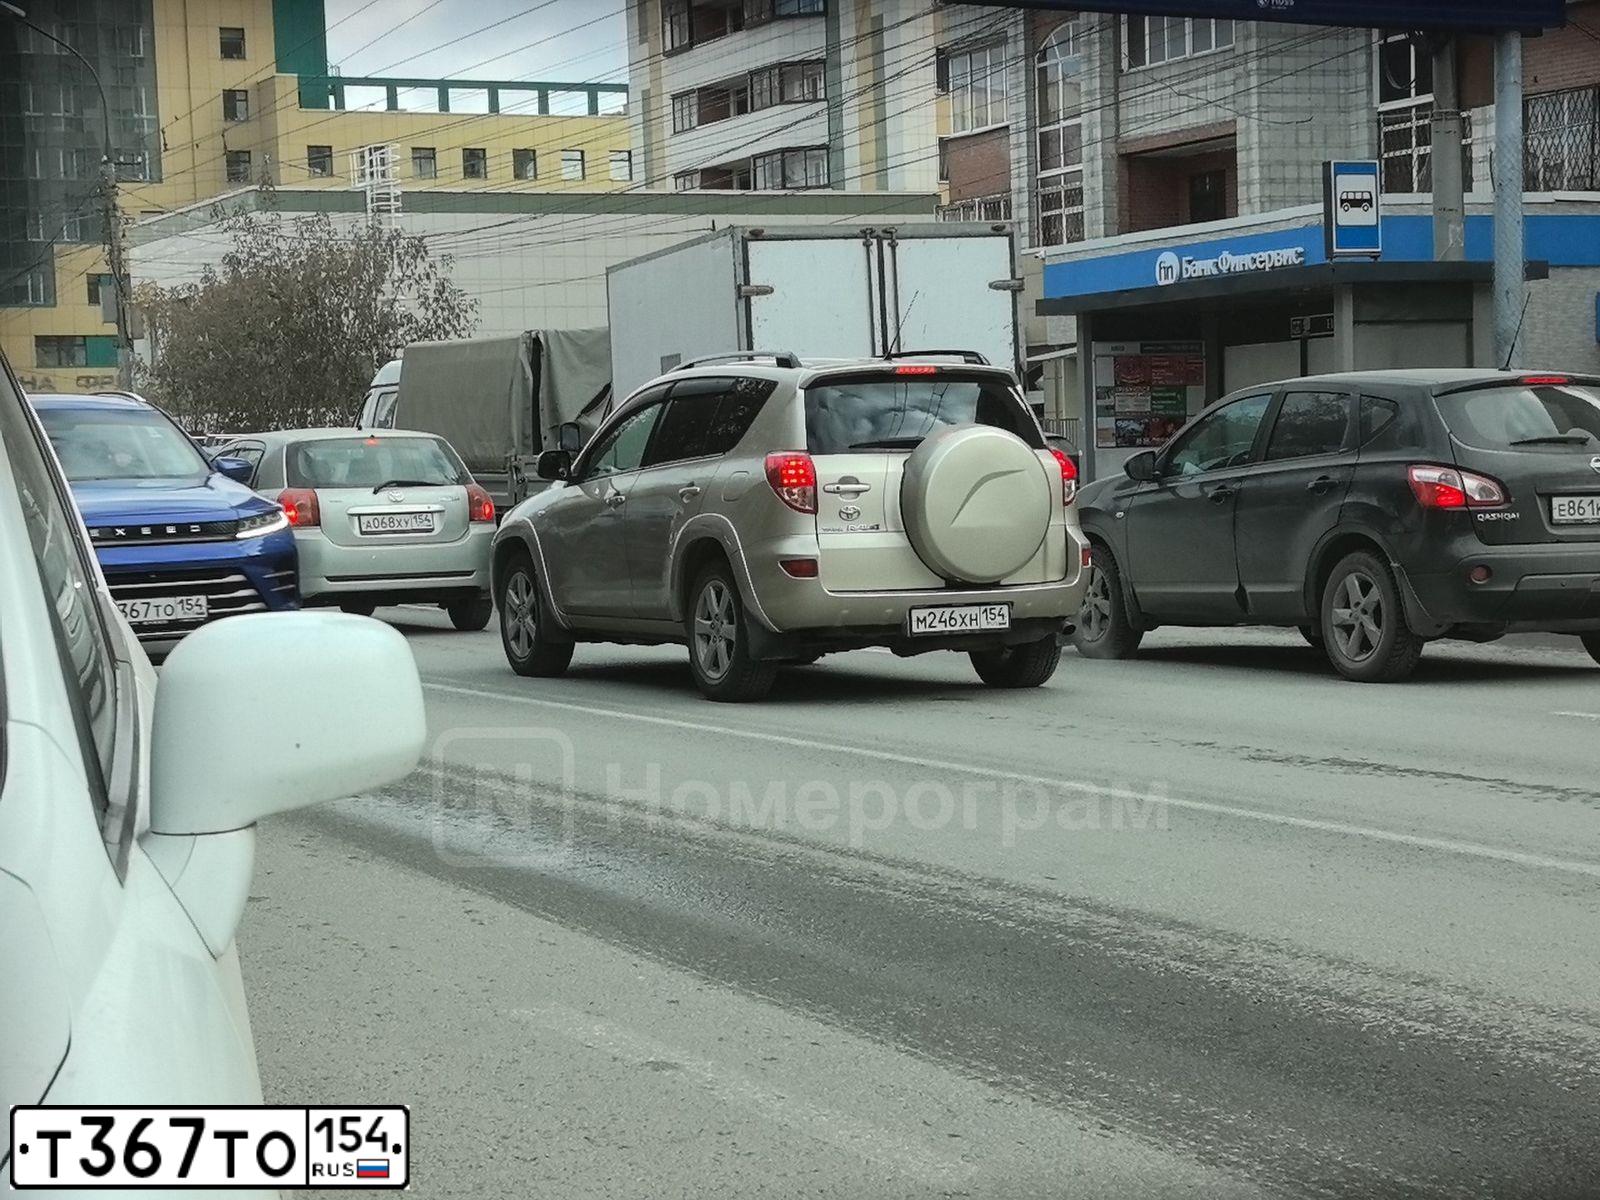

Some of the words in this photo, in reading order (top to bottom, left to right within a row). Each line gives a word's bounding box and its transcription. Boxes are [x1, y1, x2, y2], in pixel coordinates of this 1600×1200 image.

[1182, 256, 1217, 278] Банк
[1218, 247, 1304, 273] Финсервис
[412, 514, 431, 524] 154
[176, 598, 203, 611] 154
[916, 610, 979, 629] М246ХН
[981, 607, 1005, 621] 154
